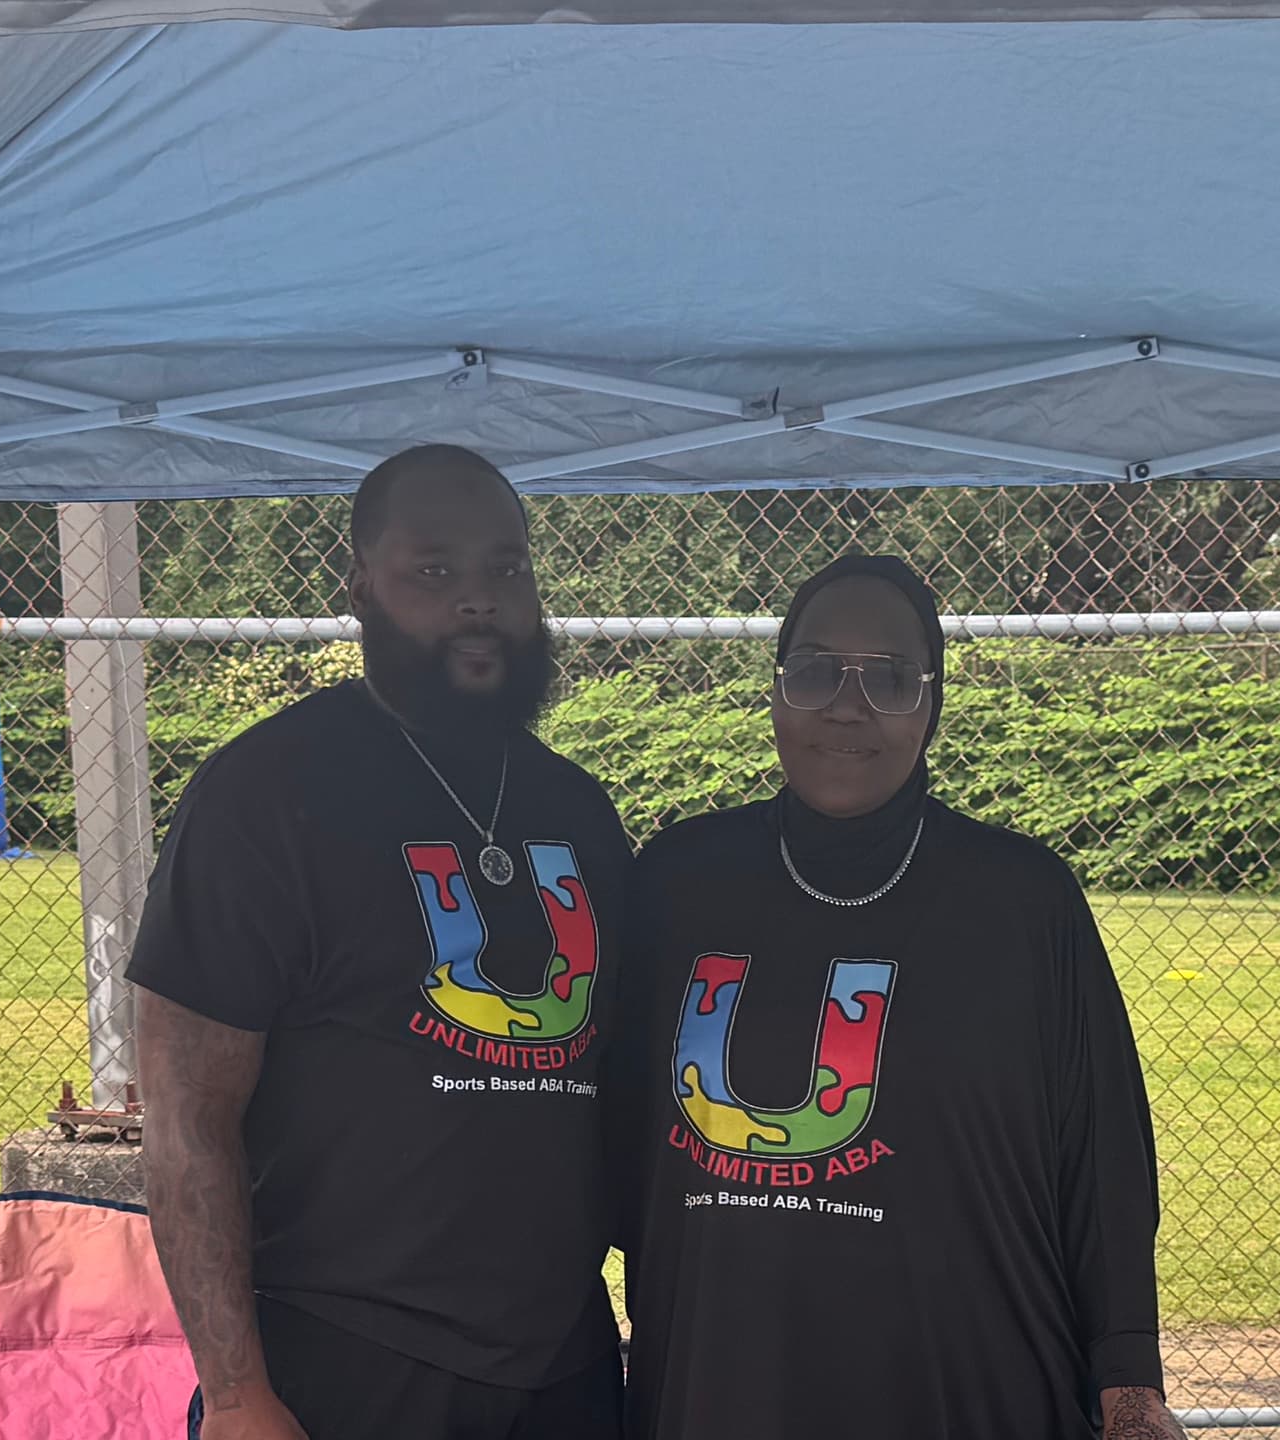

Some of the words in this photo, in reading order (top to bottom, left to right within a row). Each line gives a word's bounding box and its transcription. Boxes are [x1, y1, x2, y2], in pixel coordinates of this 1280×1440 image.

[409, 1012, 565, 1070] UNLIMITED
[569, 1023, 597, 1063] ABA
[432, 1075, 485, 1092] Sports
[490, 1076, 535, 1091] Based
[539, 1078, 563, 1092] ABA
[566, 1080, 597, 1098] Trainig
[669, 1124, 814, 1186] UNLIMITED
[826, 1139, 895, 1181] ABA
[718, 1192, 768, 1206] Based
[773, 1195, 811, 1210] ABA
[816, 1198, 883, 1222] Training
